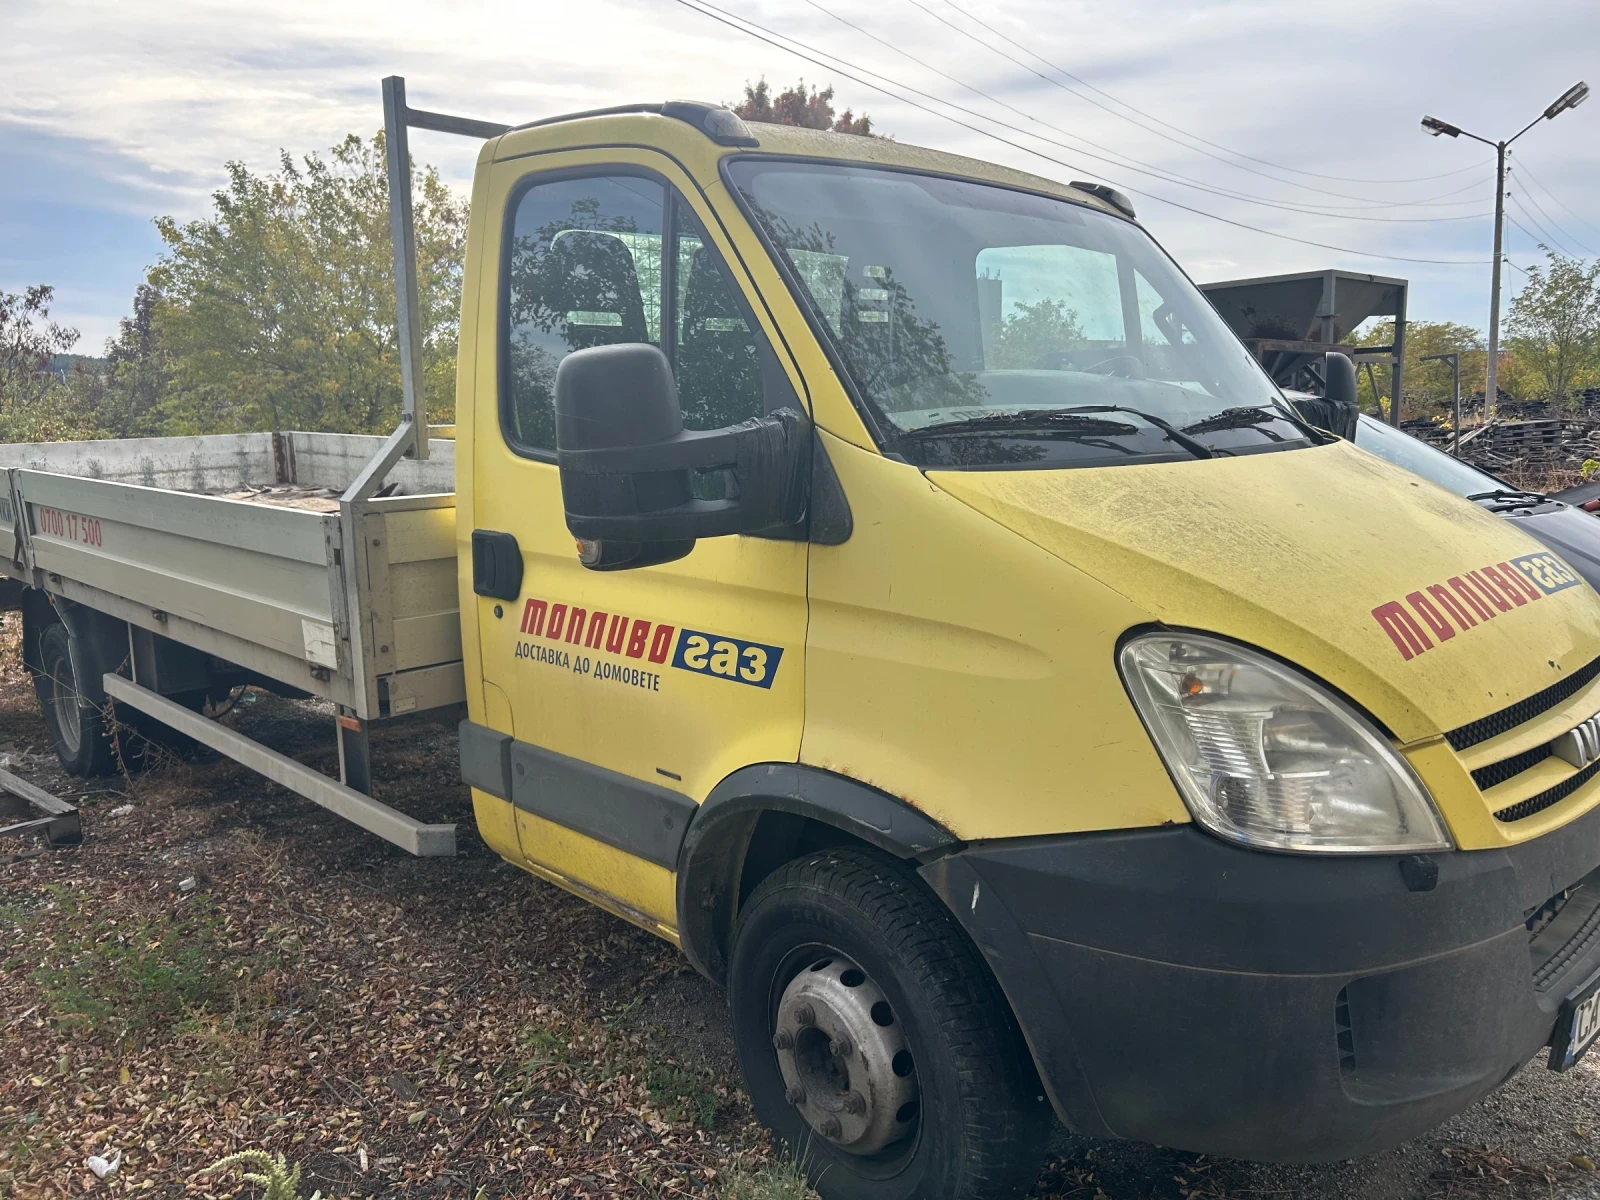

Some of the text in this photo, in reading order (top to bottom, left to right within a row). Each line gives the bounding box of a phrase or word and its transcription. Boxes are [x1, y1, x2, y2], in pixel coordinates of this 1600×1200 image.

[40, 507, 64, 537] 0700
[66, 513, 78, 541] 17
[81, 516, 102, 548] 500
[515, 641, 660, 692] ДОСТАВКА ДО ДОМОВЕТЕ
